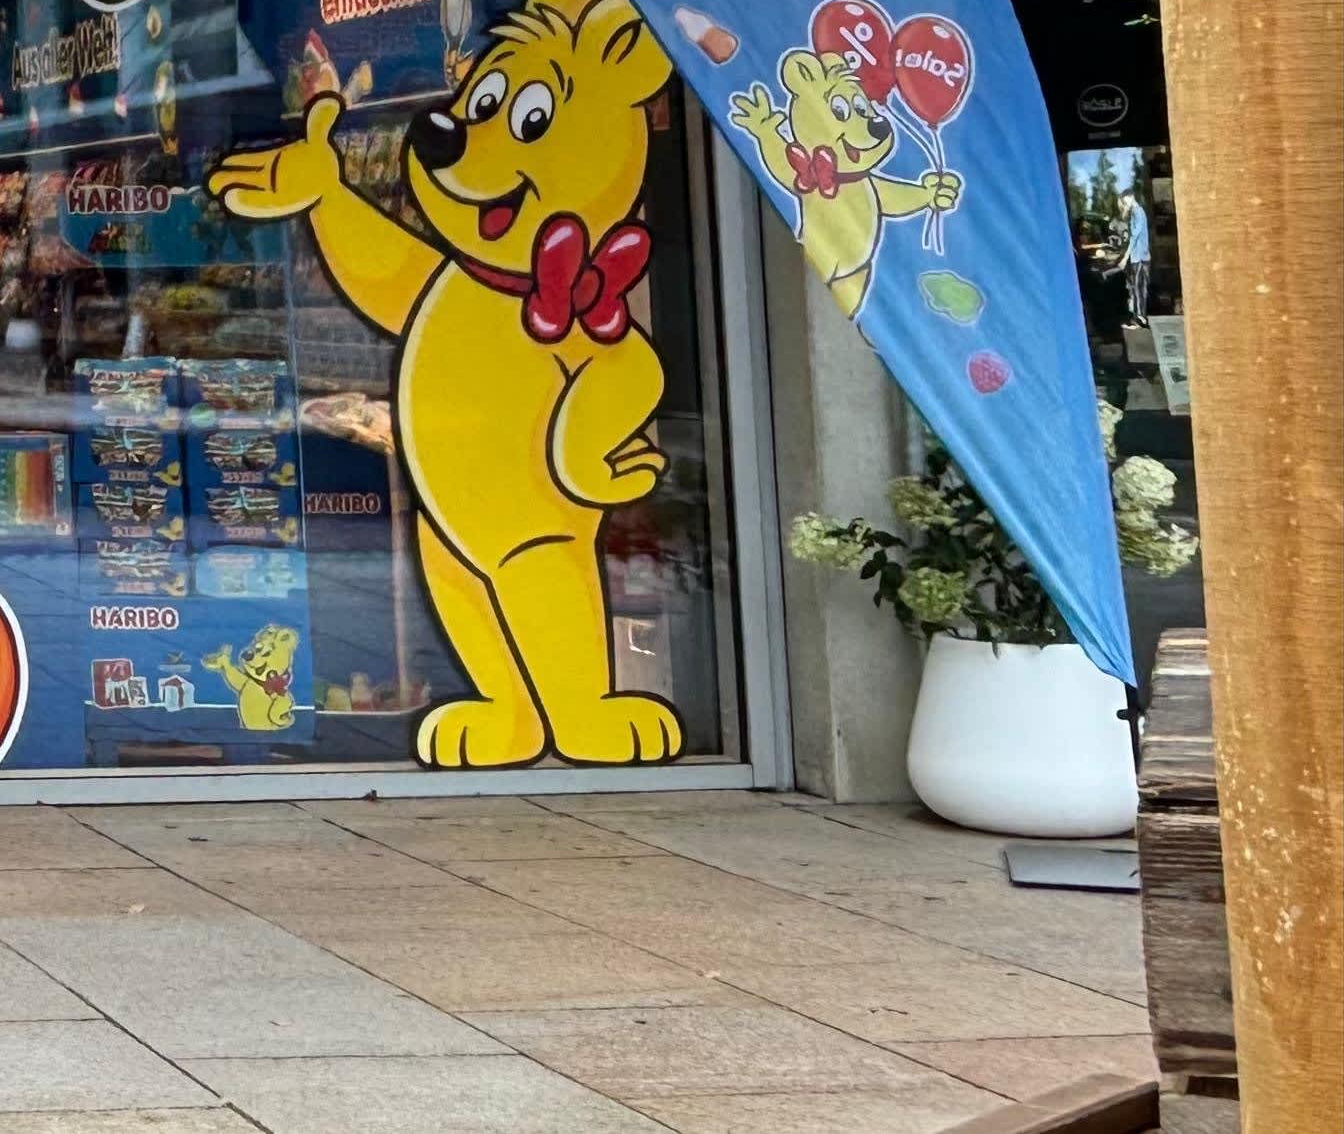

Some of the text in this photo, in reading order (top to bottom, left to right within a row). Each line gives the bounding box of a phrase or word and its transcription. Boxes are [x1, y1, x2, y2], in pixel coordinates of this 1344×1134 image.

[67, 185, 171, 215] HARIBO
[303, 493, 381, 514] HARIBO
[90, 607, 179, 630] HARIBO
